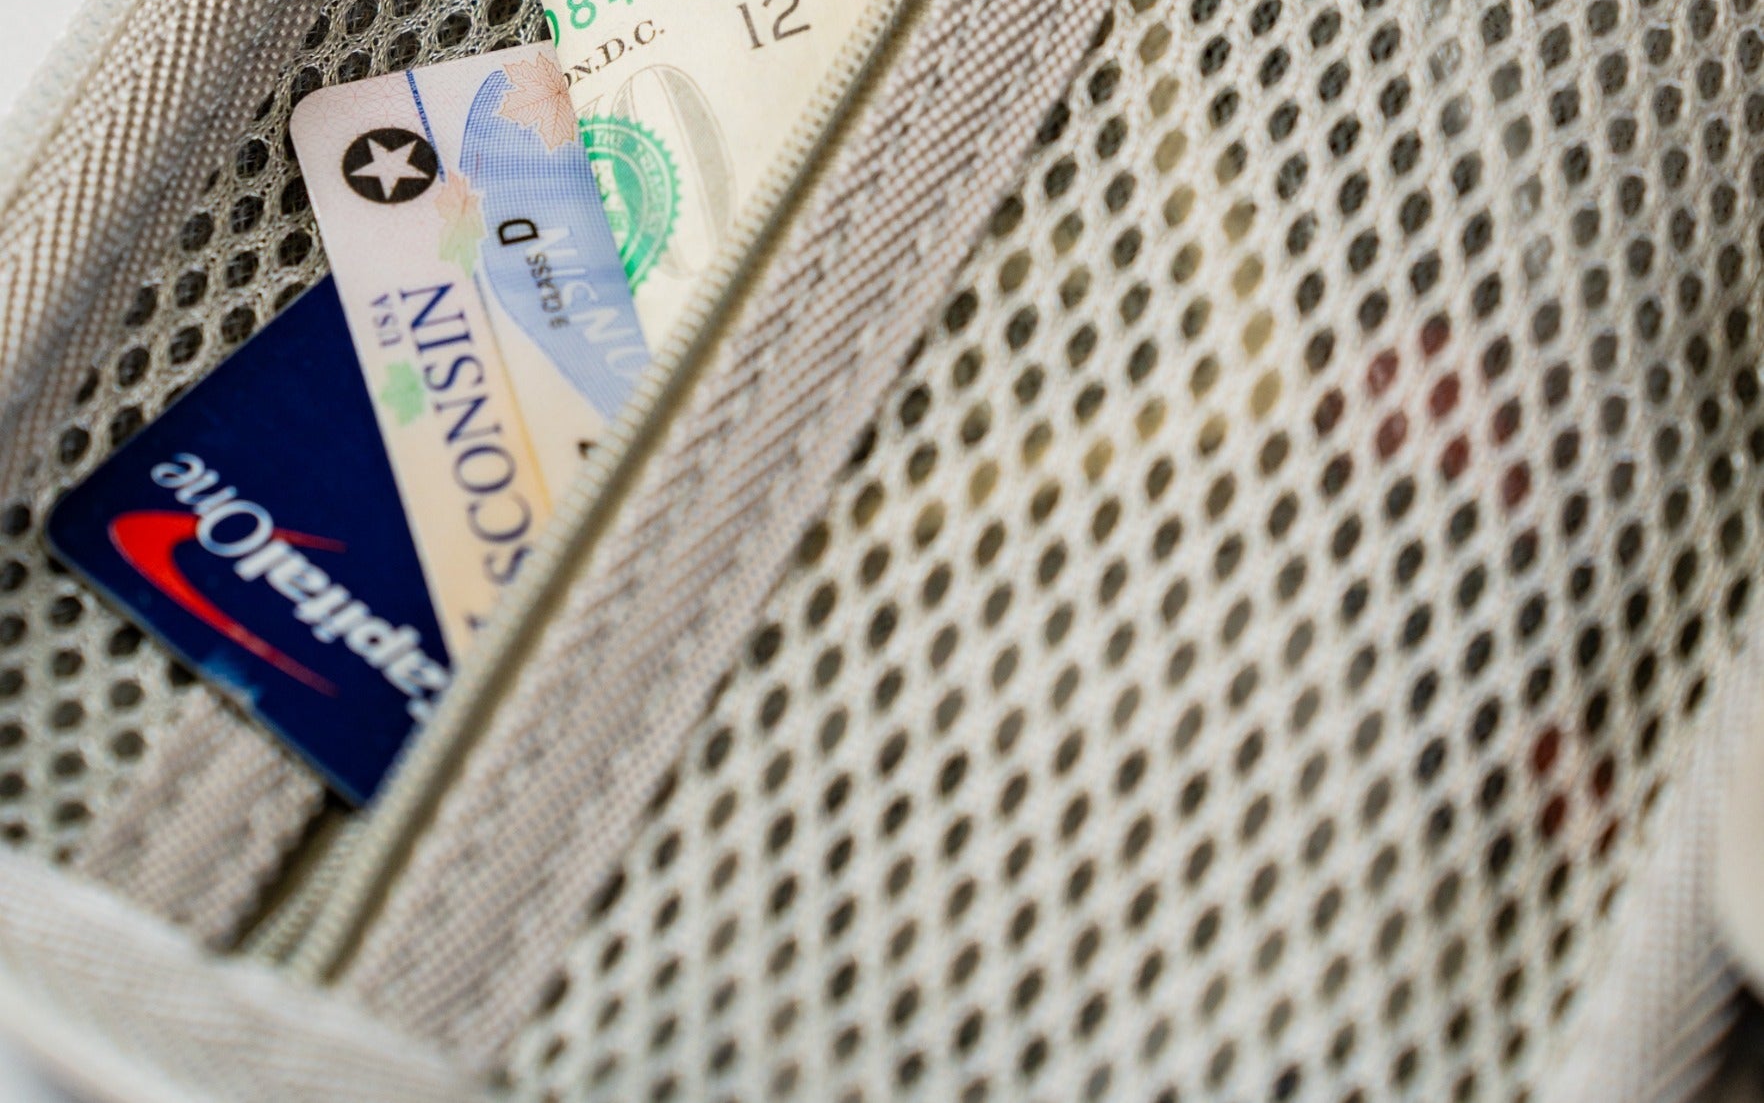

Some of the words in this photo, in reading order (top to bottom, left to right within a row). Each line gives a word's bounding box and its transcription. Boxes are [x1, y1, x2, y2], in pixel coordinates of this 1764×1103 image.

[497, 218, 539, 245] D
[526, 252, 563, 314] CLASS
[369, 292, 402, 348] USA
[400, 282, 533, 585] SCONSIN
